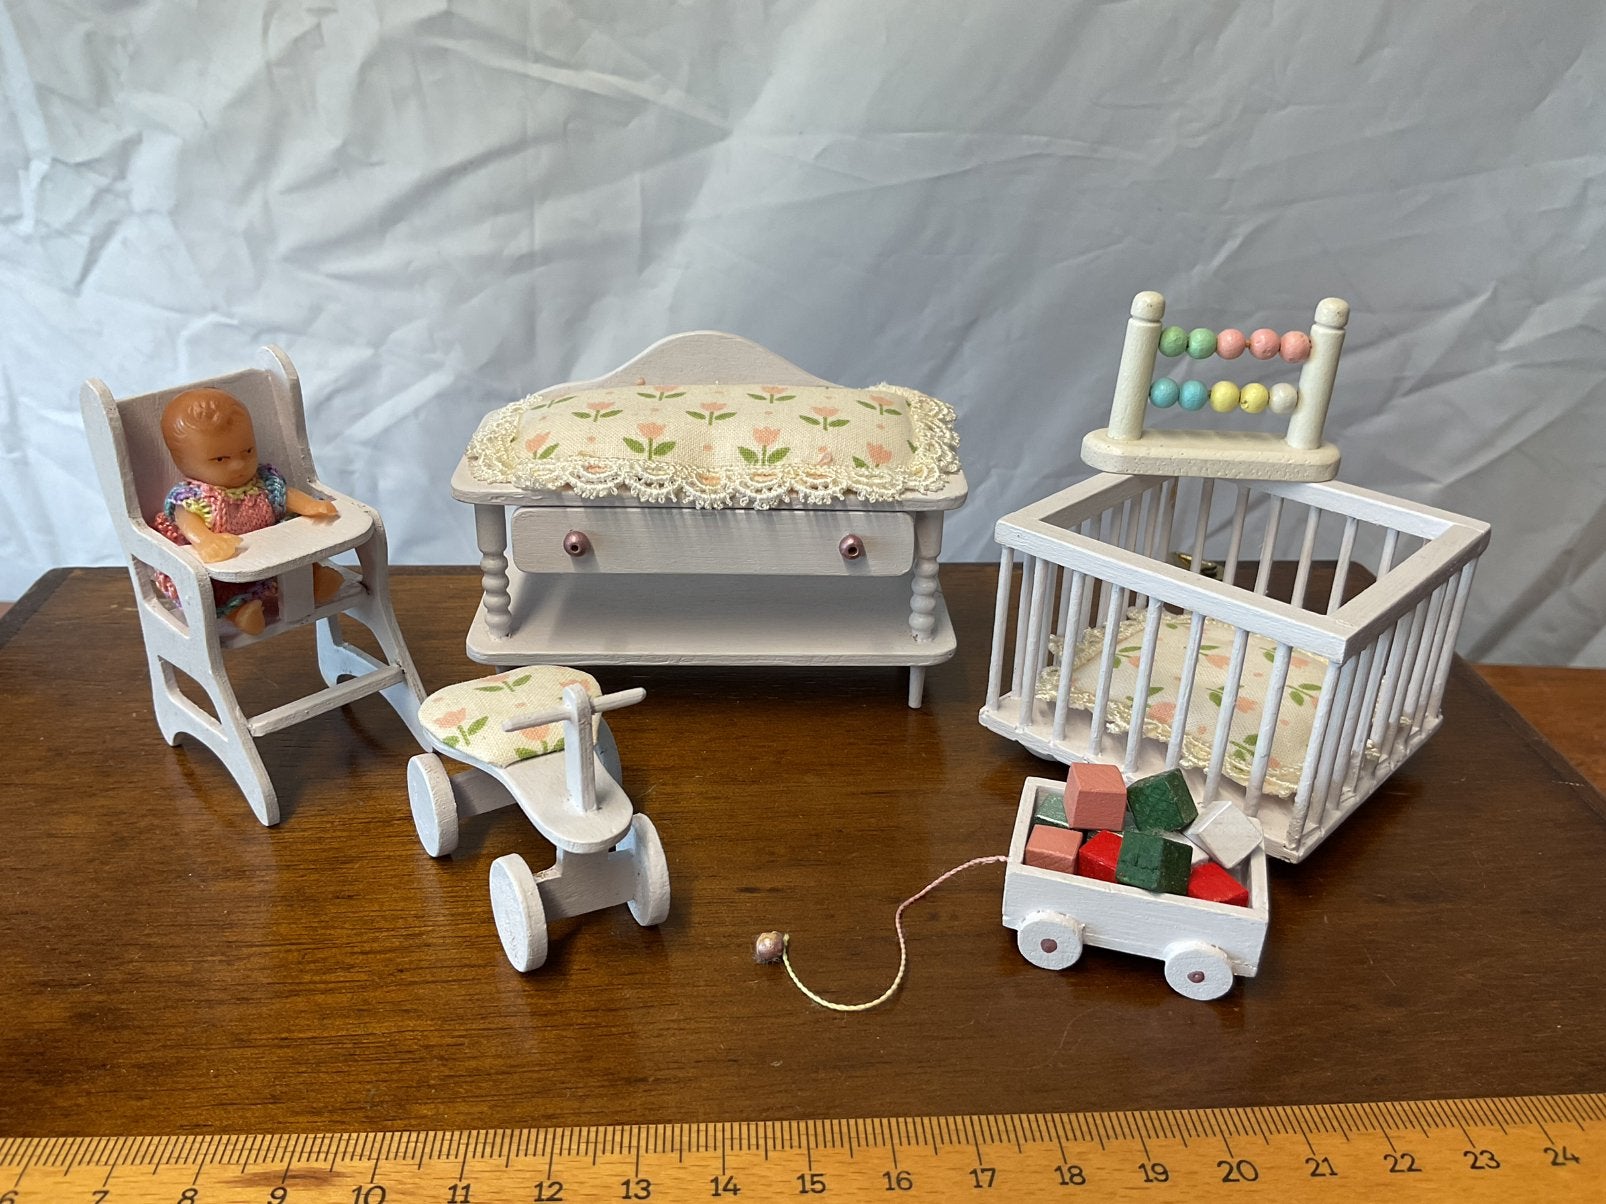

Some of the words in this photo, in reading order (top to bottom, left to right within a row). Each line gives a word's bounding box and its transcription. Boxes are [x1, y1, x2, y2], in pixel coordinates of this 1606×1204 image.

[177, 1188, 198, 1204] 8
[267, 1186, 287, 1204] 9
[352, 1185, 386, 1204] 10
[447, 1184, 470, 1204] 11
[534, 1181, 563, 1202] 12
[621, 1179, 652, 1200] 13
[710, 1176, 741, 1196] 14
[797, 1174, 826, 1194] 15
[883, 1171, 913, 1190] 16
[969, 1168, 996, 1188] 17
[1055, 1166, 1086, 1185] 18
[1139, 1163, 1169, 1182] 19
[1217, 1160, 1258, 1182] 20
[1305, 1157, 1338, 1177] 21
[1384, 1153, 1422, 1173] 22
[1464, 1150, 1500, 1169] 23
[1544, 1146, 1579, 1166] 24
